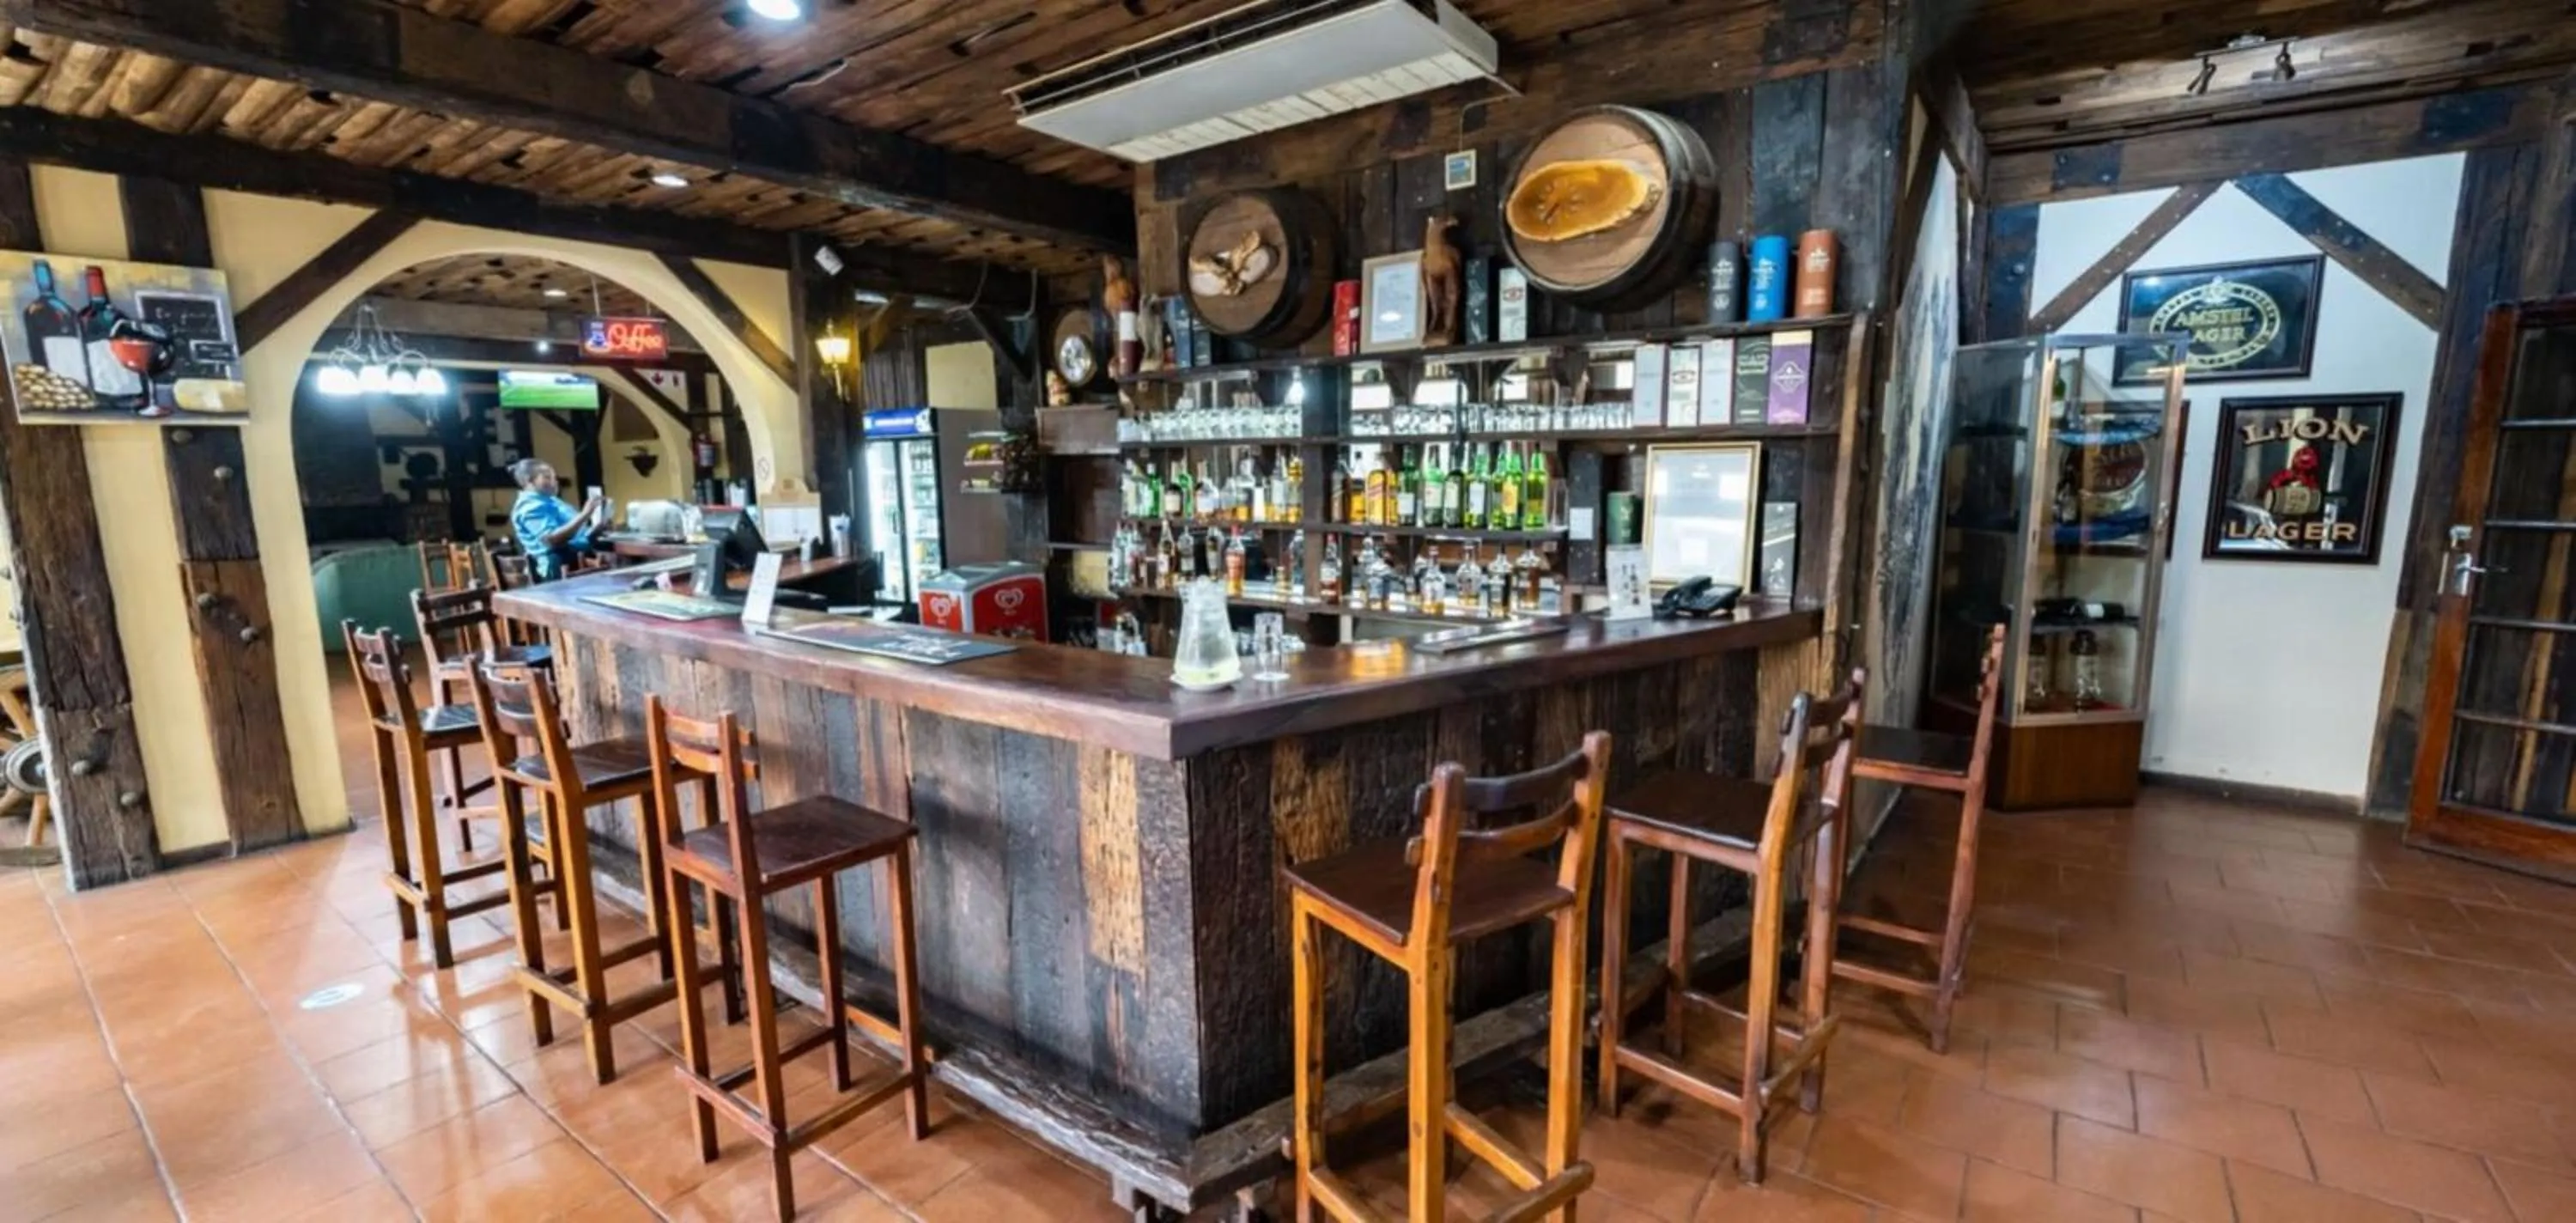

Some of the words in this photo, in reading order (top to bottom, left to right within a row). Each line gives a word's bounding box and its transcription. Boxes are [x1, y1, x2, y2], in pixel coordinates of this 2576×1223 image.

[2172, 306, 2255, 328] AMSTEL
[607, 323, 663, 353] Coffee
[2189, 325, 2246, 344] AGER
[2243, 417, 2370, 446] LION
[2228, 520, 2357, 541] LAGER
